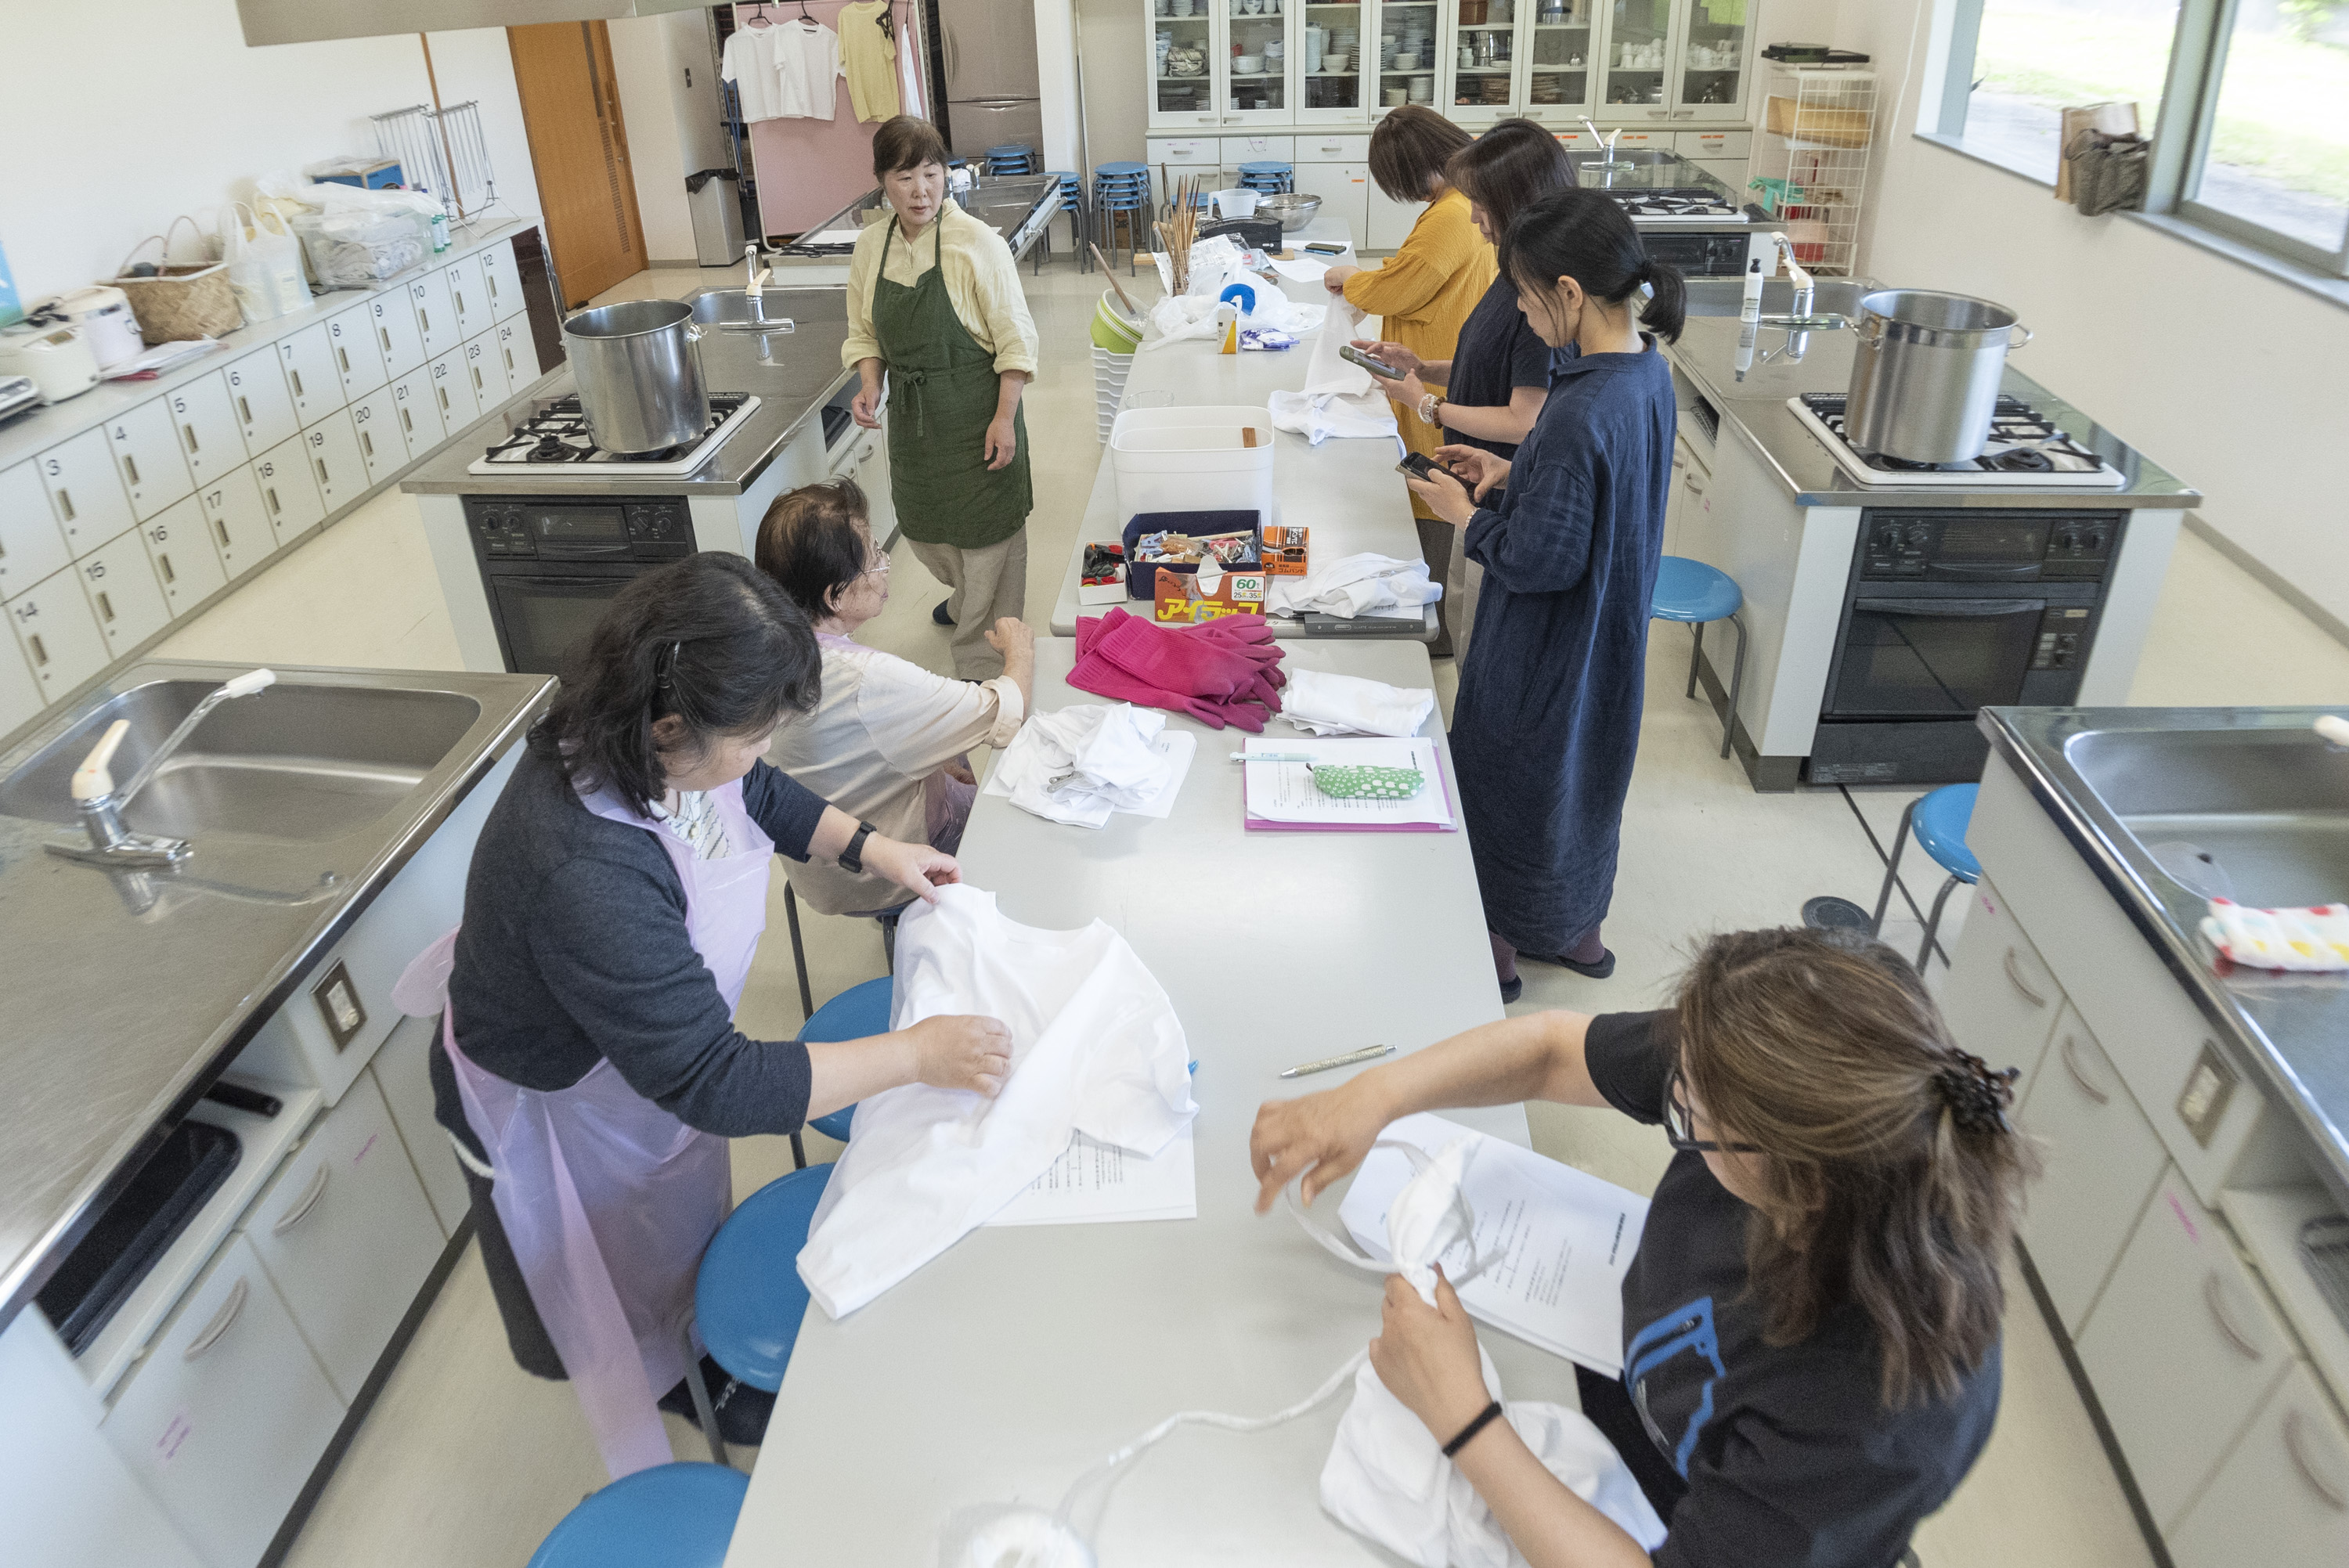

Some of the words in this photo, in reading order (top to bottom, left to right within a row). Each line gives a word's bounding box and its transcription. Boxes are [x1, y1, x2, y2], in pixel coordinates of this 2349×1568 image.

[483, 254, 493, 266] 12
[451, 269, 460, 282] 11
[413, 286, 424, 299] 10
[375, 305, 382, 317] 9
[332, 323, 341, 337] 8
[501, 327, 511, 341] 24
[283, 345, 290, 359] 7
[469, 344, 480, 359] 23
[435, 363, 447, 379] 22
[230, 372, 240, 386] 6
[397, 385, 409, 400] 21
[174, 398, 186, 414] 5
[355, 406, 370, 424] 20
[115, 426, 127, 440] 4
[309, 432, 323, 448] 19
[48, 460, 60, 476] 3
[258, 463, 273, 479] 18
[207, 491, 221, 508] 17
[150, 525, 167, 543] 16
[86, 561, 105, 581] 15
[1236, 579, 1256, 589] 60
[16, 602, 38, 622] 14
